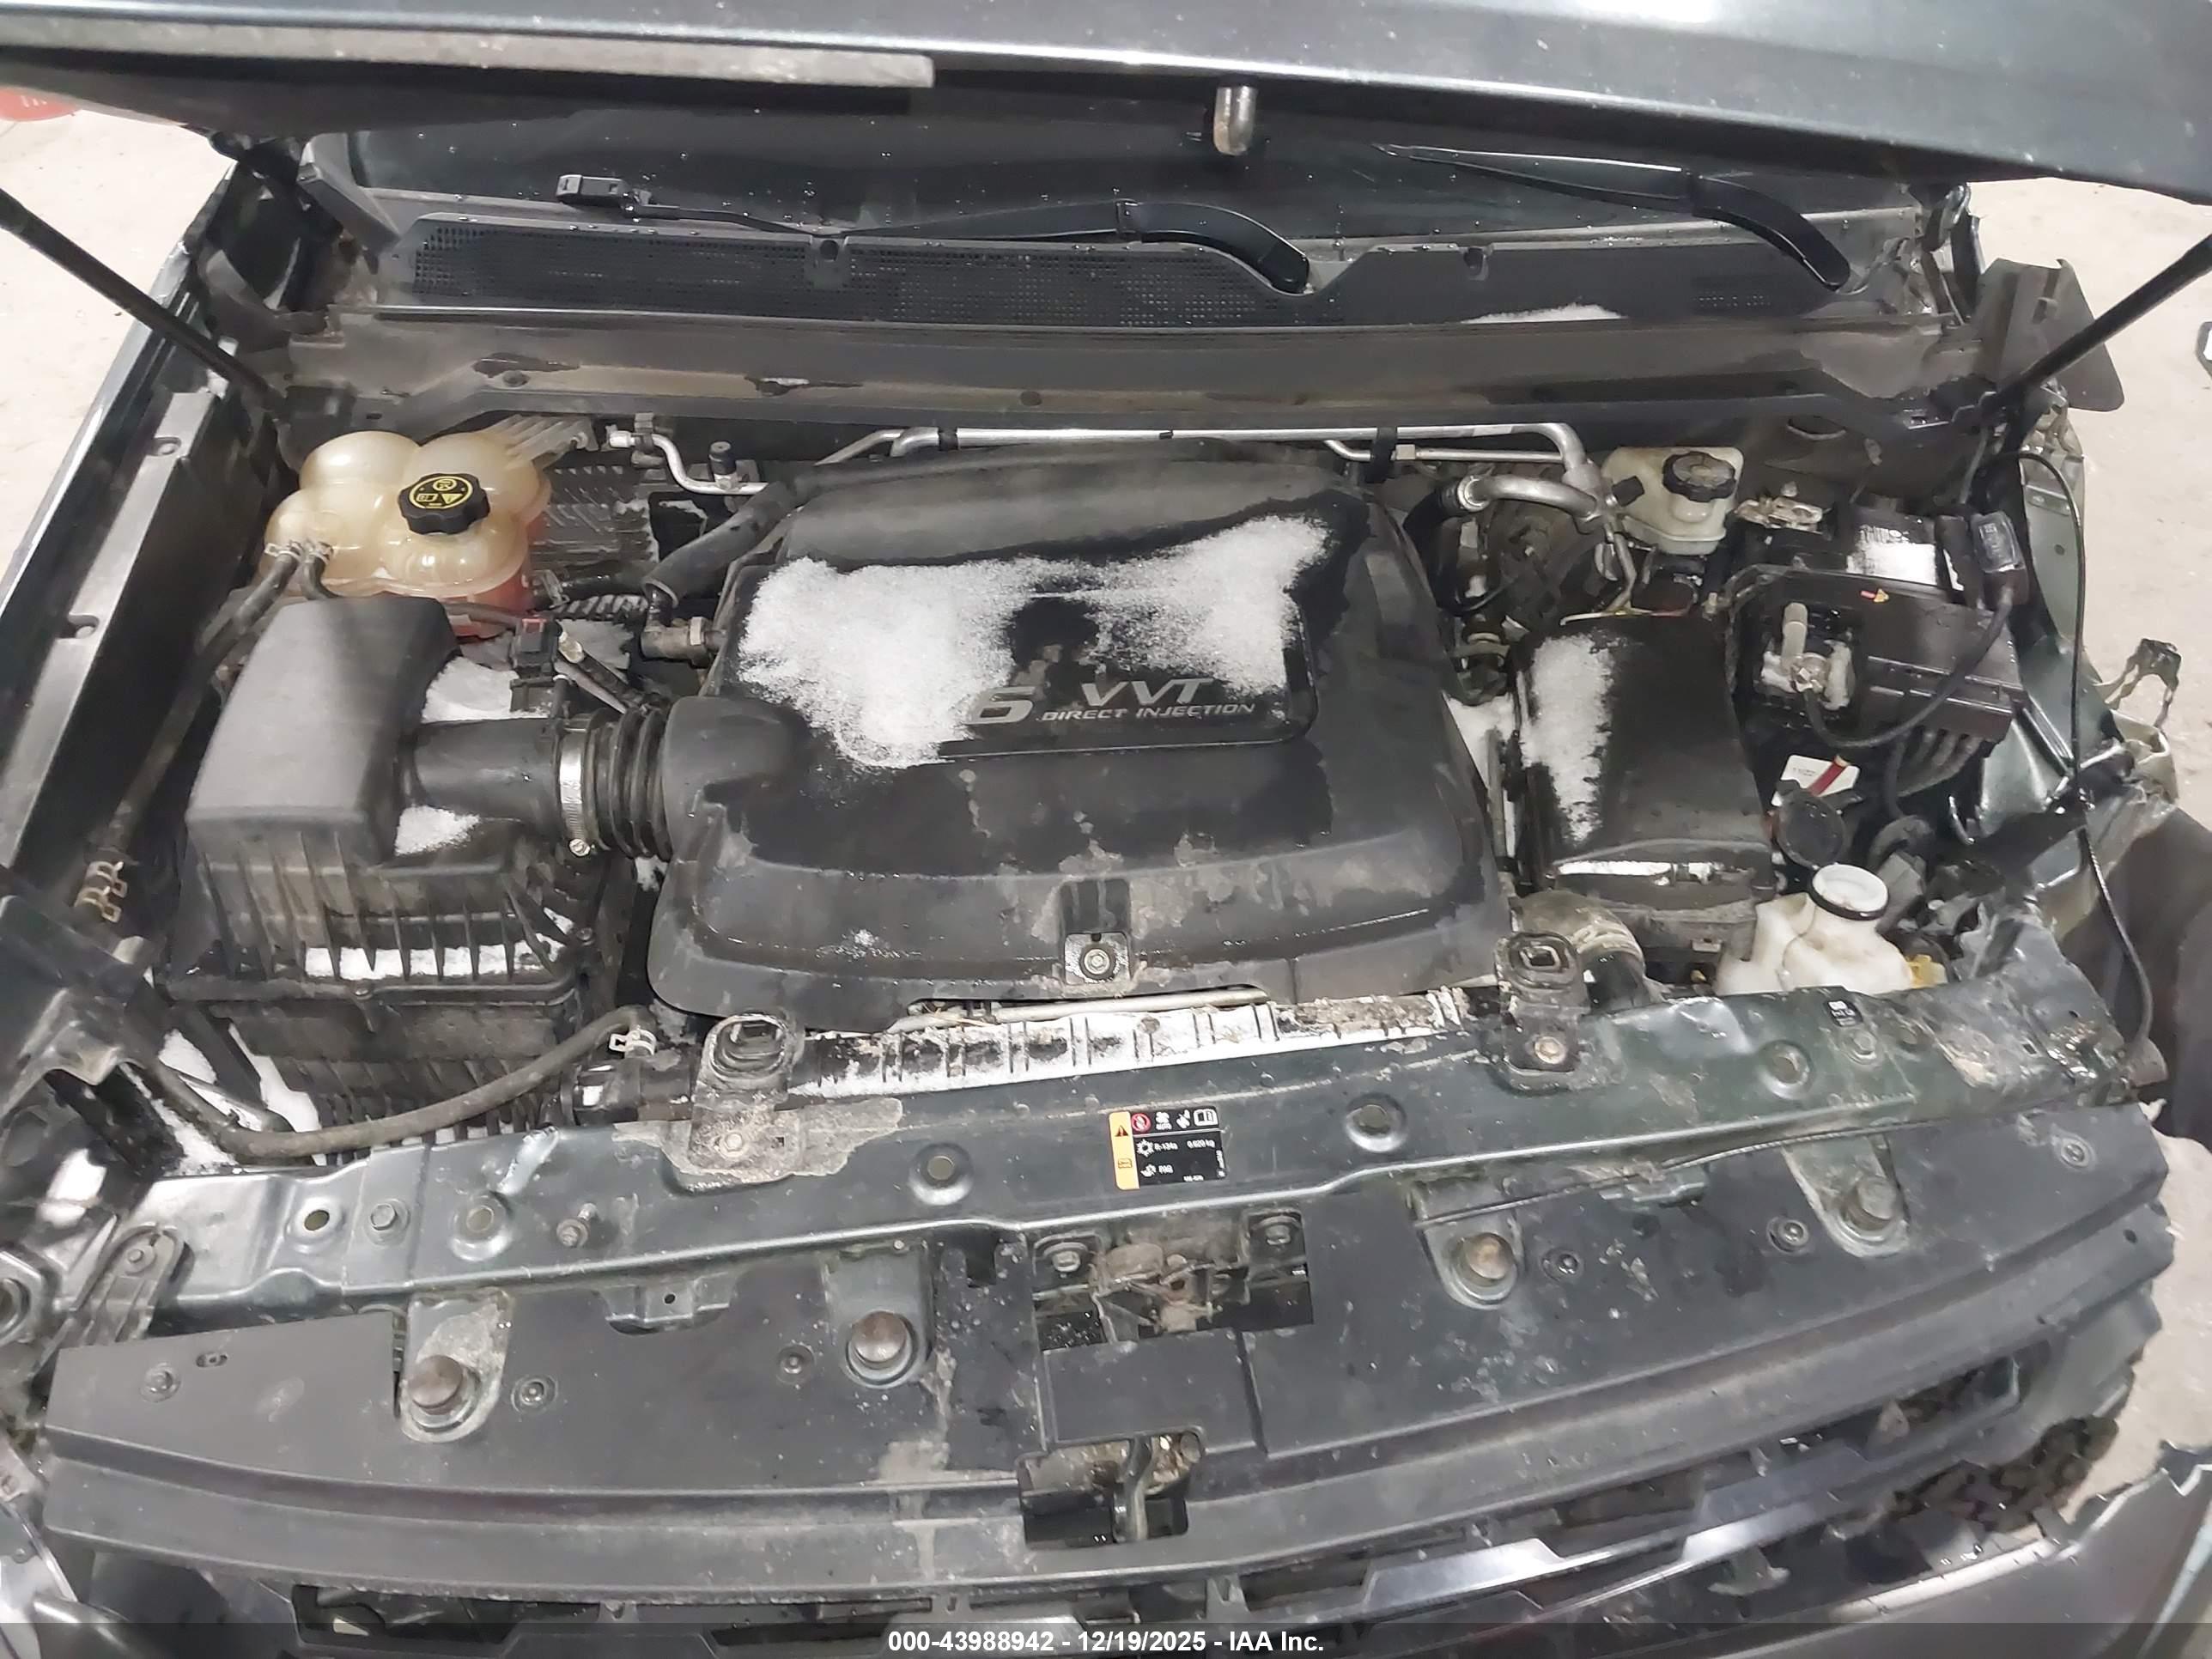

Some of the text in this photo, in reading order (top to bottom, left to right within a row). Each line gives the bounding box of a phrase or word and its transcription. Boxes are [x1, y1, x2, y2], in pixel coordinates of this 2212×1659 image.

[1081, 678, 1214, 707] VVT
[1042, 703, 1255, 721] DIRECT INJECTION
